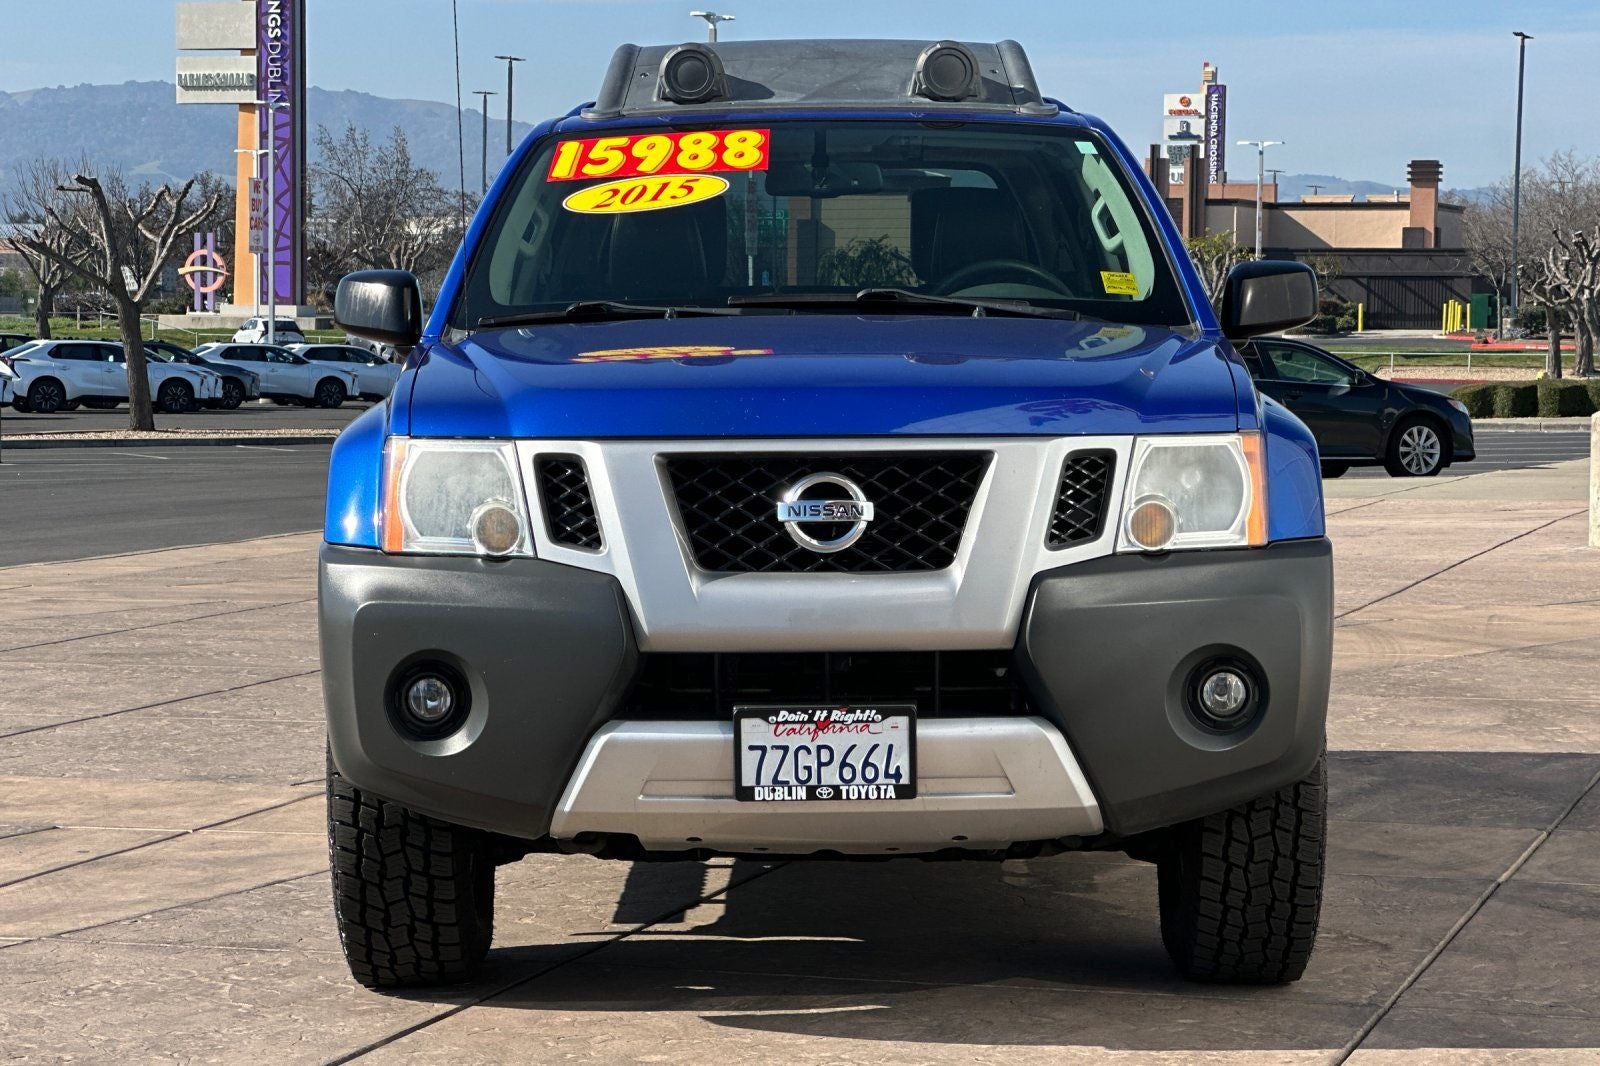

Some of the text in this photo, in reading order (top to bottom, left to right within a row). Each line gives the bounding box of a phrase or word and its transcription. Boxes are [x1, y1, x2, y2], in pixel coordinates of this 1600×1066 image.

[268, 43, 281, 103] DUBLIN
[551, 130, 766, 178] 15988
[253, 180, 261, 194] WE
[592, 178, 700, 209] 2015
[251, 198, 262, 212] BUY
[250, 217, 263, 231] CARS
[788, 504, 864, 517] NISSAN
[777, 710, 876, 725] Doin' It Right!
[748, 743, 902, 786] 7ZGP664
[754, 786, 896, 800] DUBLIN TOYOTA
